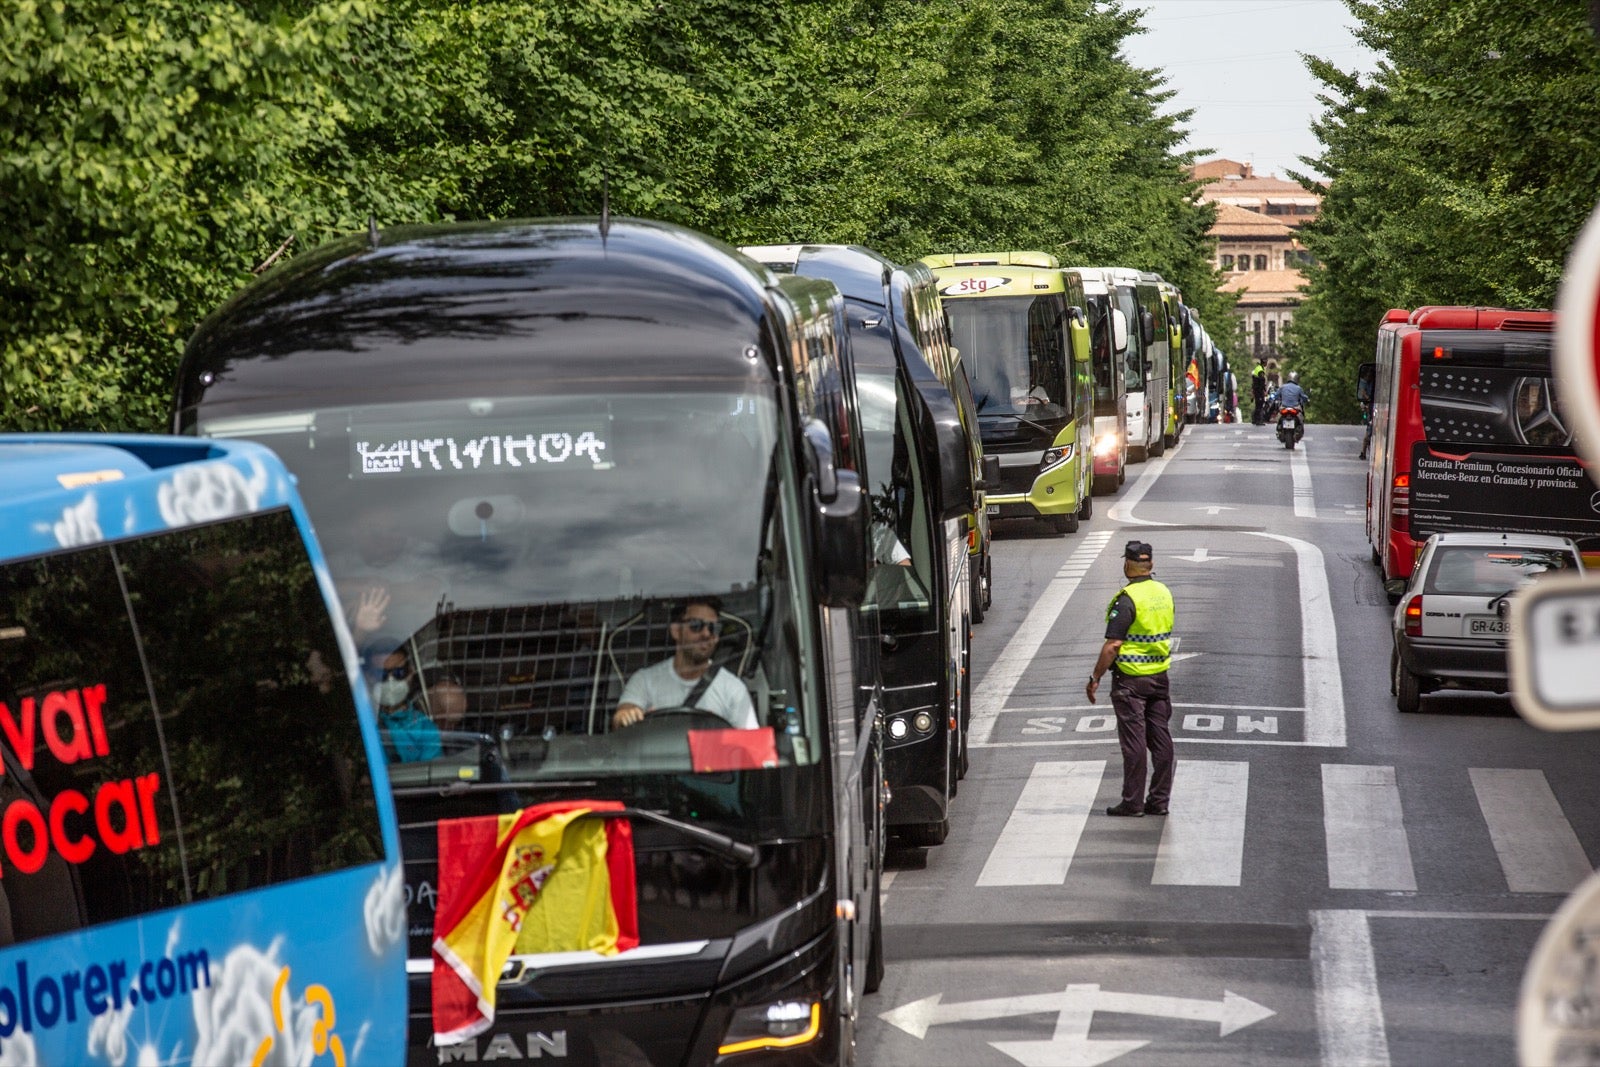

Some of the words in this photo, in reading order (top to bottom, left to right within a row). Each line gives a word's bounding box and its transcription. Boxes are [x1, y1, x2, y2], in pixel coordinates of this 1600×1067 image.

[960, 278, 987, 292] stg
[1418, 458, 1453, 469] Granada
[1454, 460, 1495, 473] Premium,
[1497, 462, 1555, 476] Concesionario
[1556, 466, 1584, 477] Oficial
[1417, 469, 1479, 483] Mercedes-Benz
[1480, 475, 1491, 483] en
[1493, 474, 1528, 486] Granada
[1529, 478, 1536, 489] y
[1537, 478, 1579, 489] provincia.
[0, 683, 110, 776] var
[1021, 713, 1279, 735] MOOS
[0, 772, 161, 879] ocar
[437, 1029, 567, 1065] MAN
